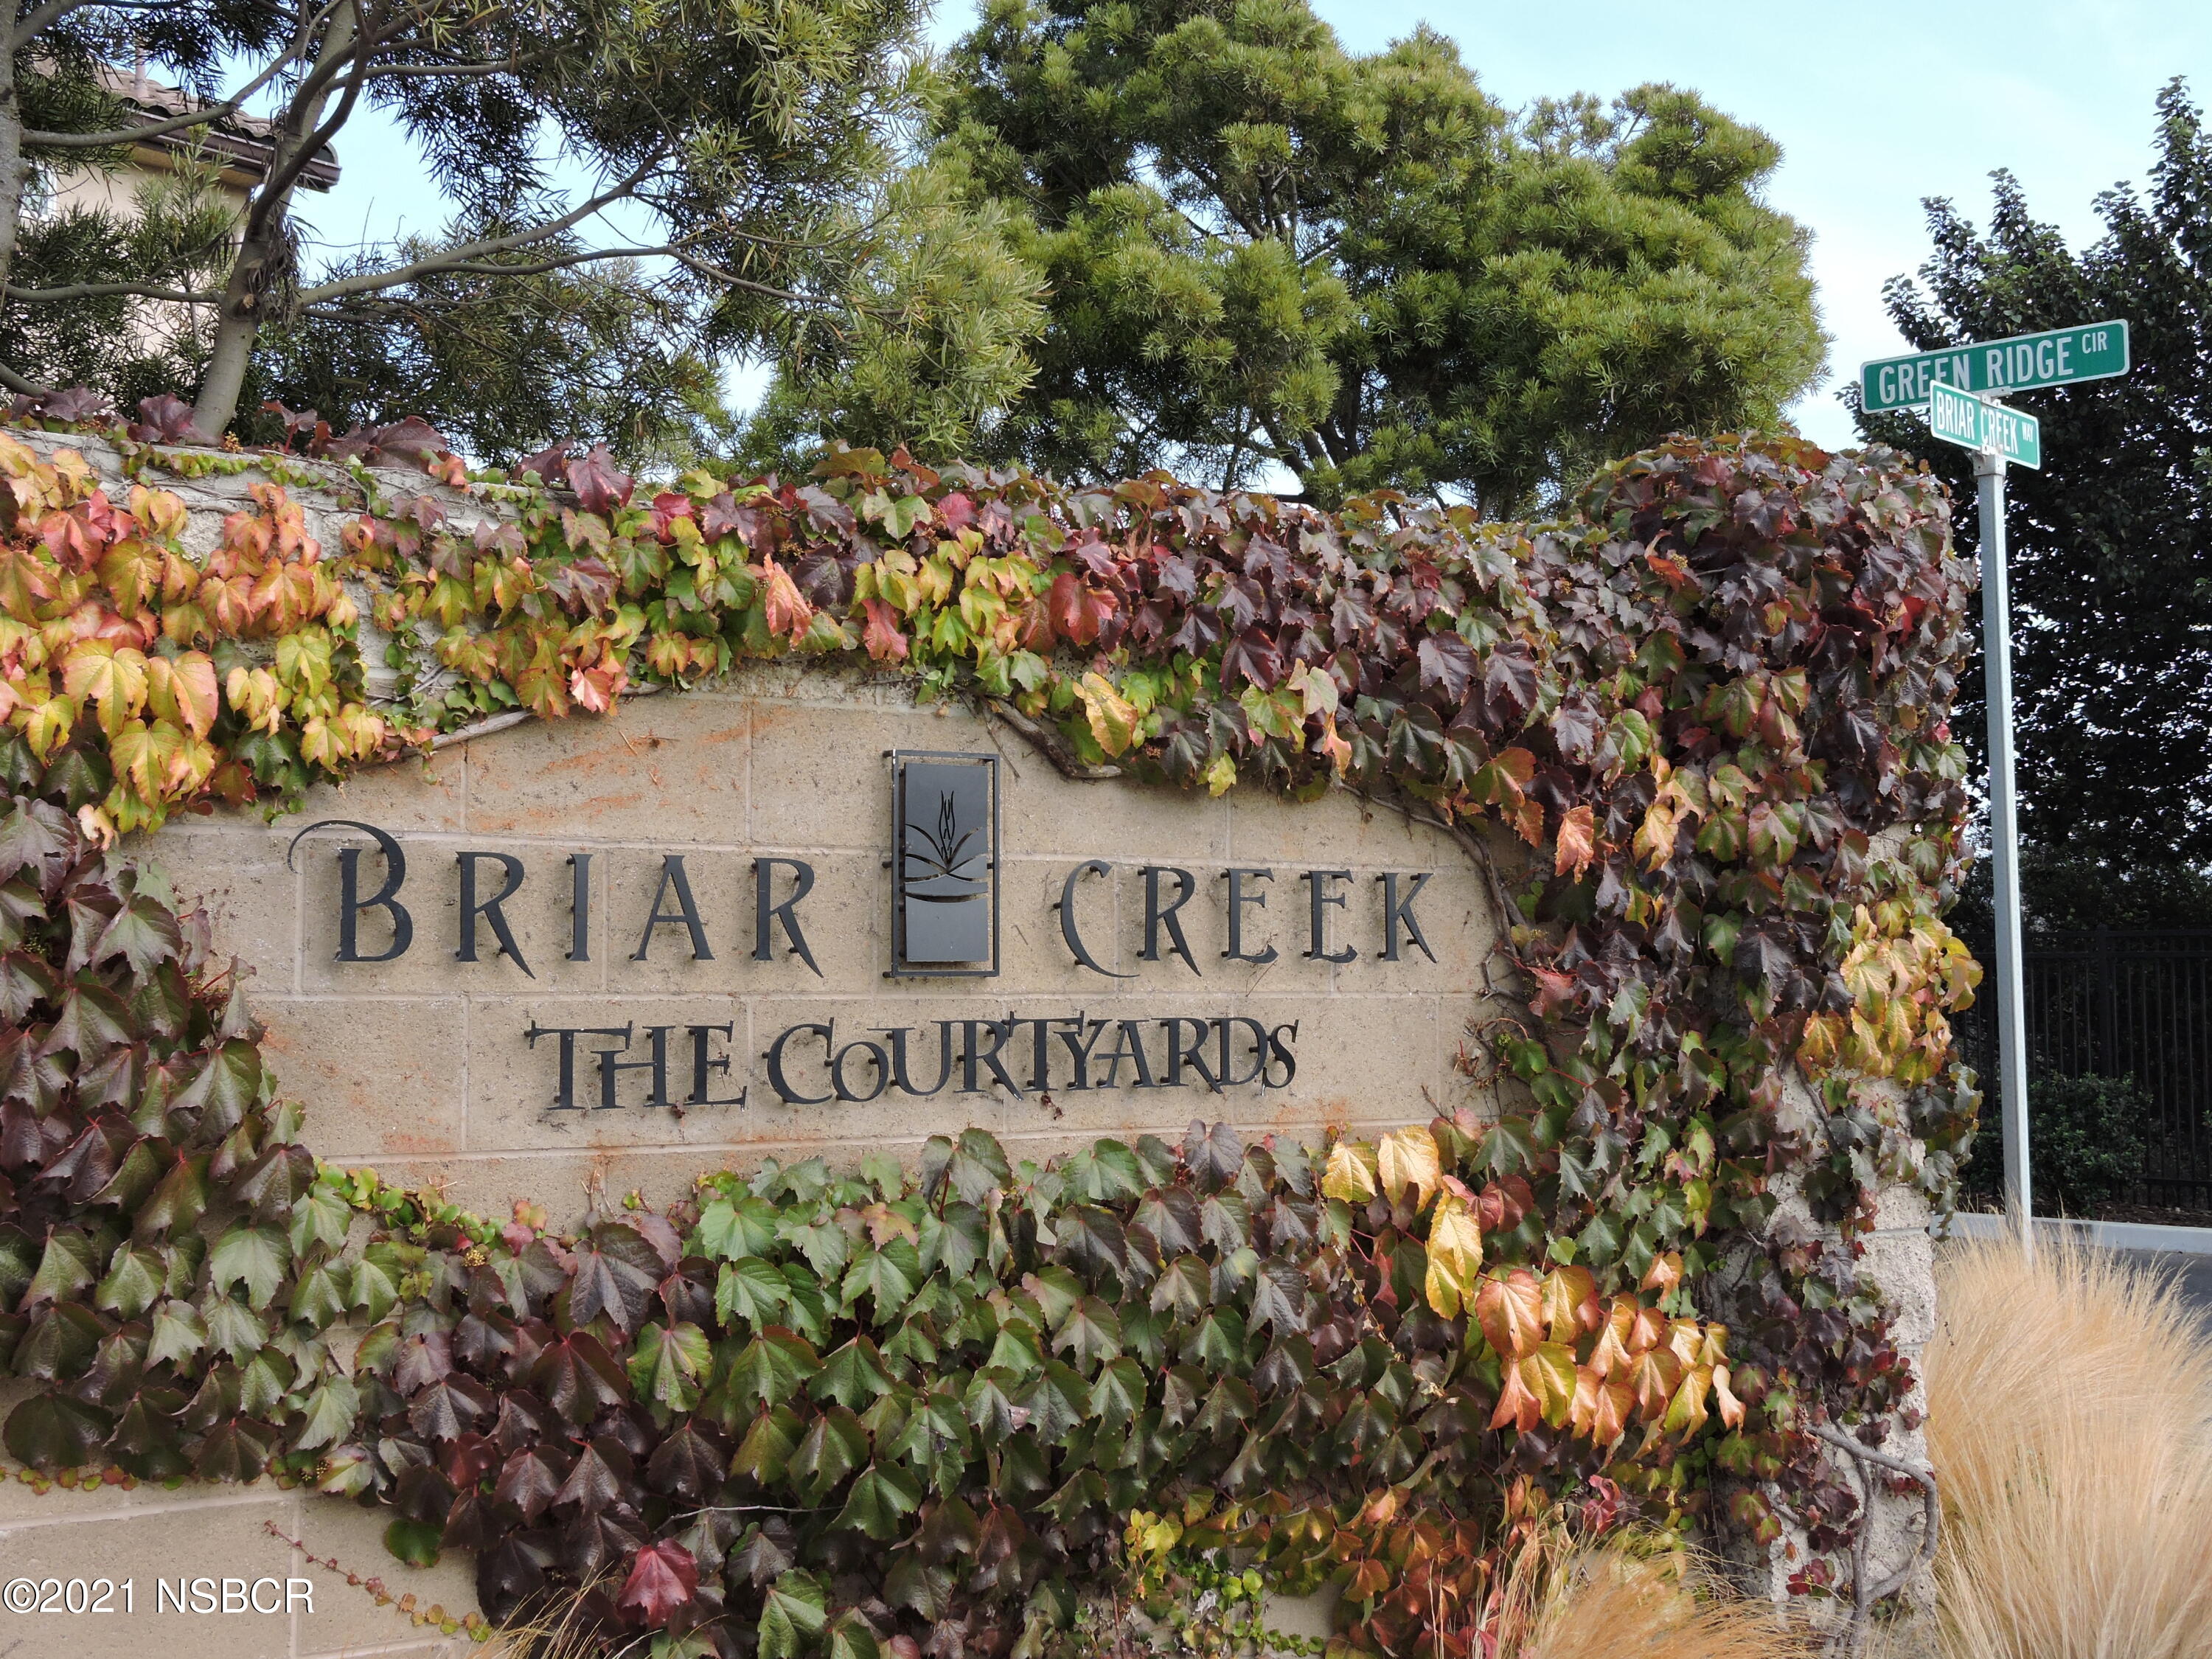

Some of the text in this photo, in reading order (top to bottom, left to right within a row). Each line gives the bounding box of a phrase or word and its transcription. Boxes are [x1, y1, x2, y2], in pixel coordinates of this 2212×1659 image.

[1878, 330, 2108, 404] GREEN RIDGE CIR
[1936, 390, 2034, 455] BRIAR CREEK WAY
[288, 819, 1439, 979] BRIAR CREEK
[524, 1009, 1299, 1112] THE COURTYARDS
